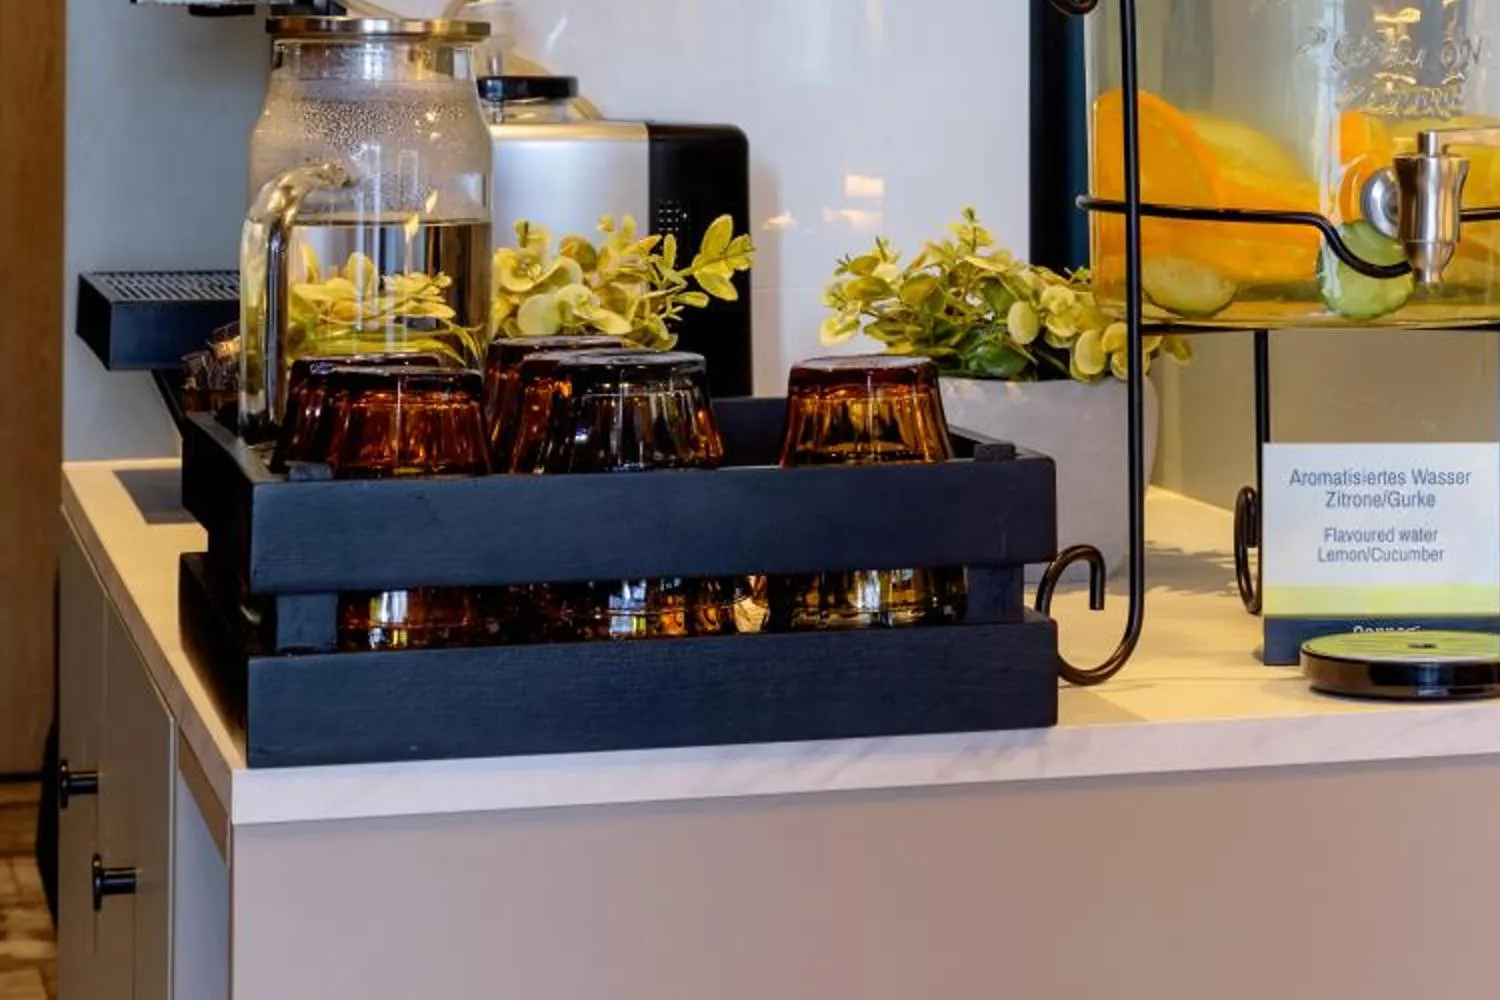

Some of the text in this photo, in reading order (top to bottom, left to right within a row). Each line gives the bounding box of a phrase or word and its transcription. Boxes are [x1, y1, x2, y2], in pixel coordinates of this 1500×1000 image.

[1289, 467, 1472, 487] Aromatisiertes Wasser
[1324, 489, 1437, 509] Zitrone/Gurke
[1323, 526, 1439, 544] Flavoured water
[1316, 545, 1446, 564] Lemon/Cucumber
